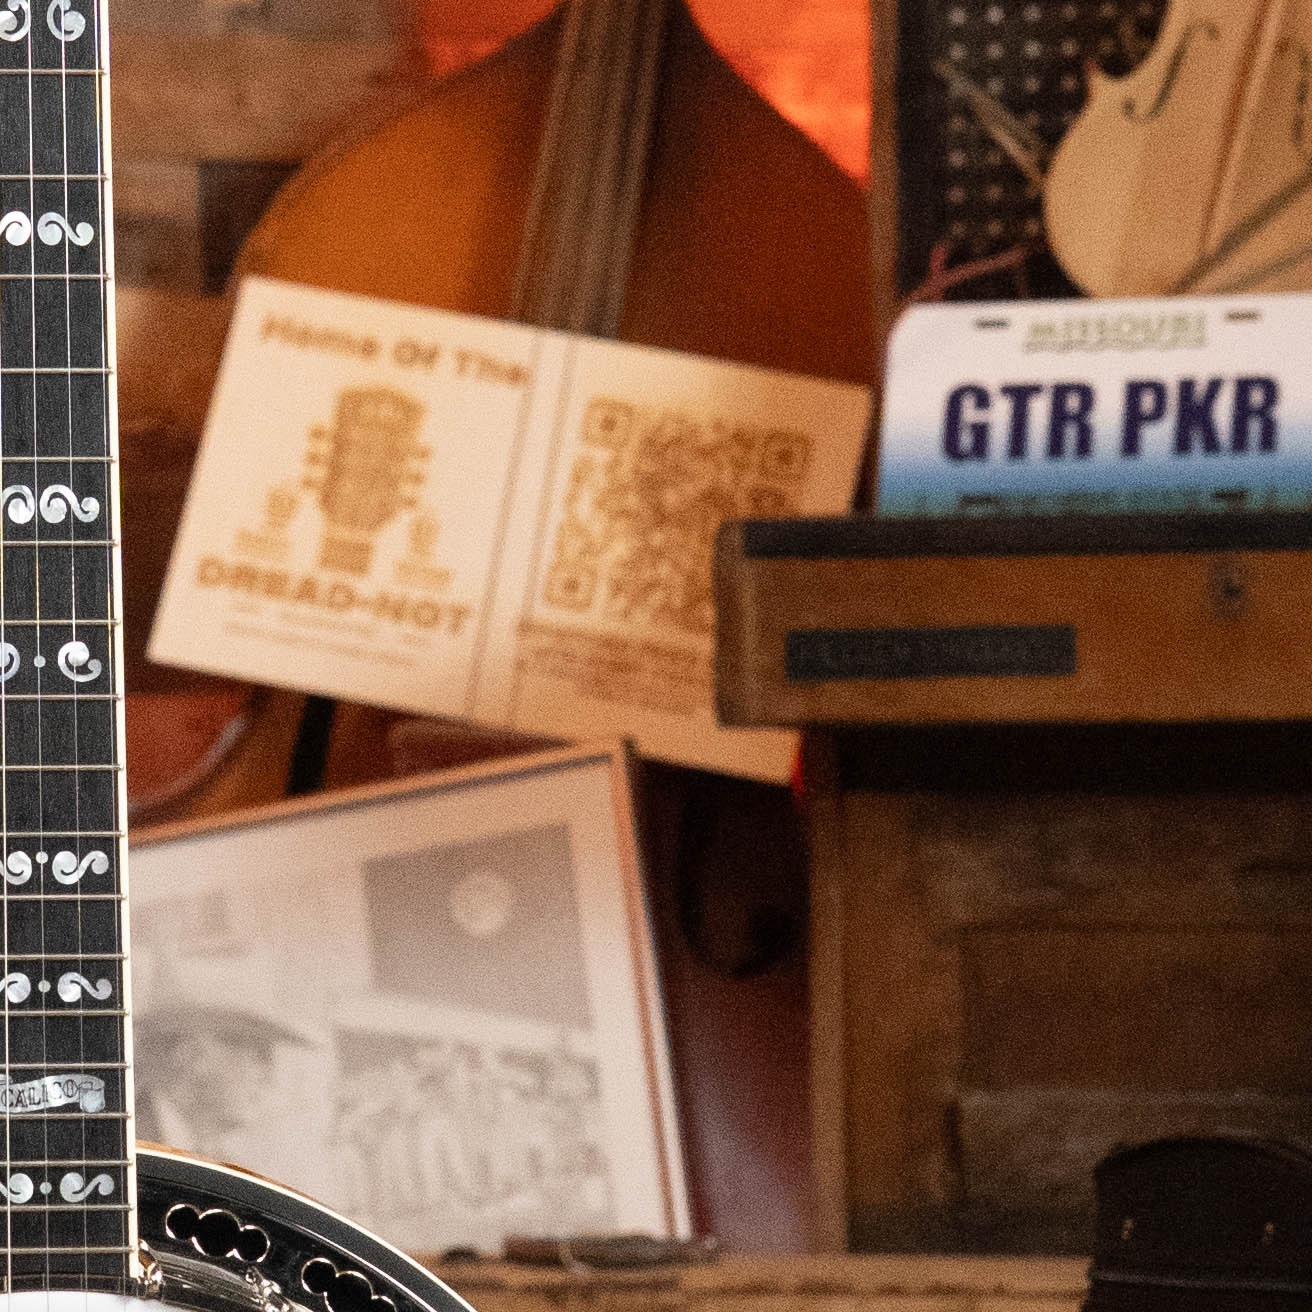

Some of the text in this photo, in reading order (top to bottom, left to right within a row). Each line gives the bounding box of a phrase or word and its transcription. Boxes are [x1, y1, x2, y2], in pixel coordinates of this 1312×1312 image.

[454, 349, 533, 386] The
[942, 376, 1281, 463] GTR PKR
[197, 556, 471, 635] DREAD-NOT
[0, 1078, 79, 1109] CALICO
